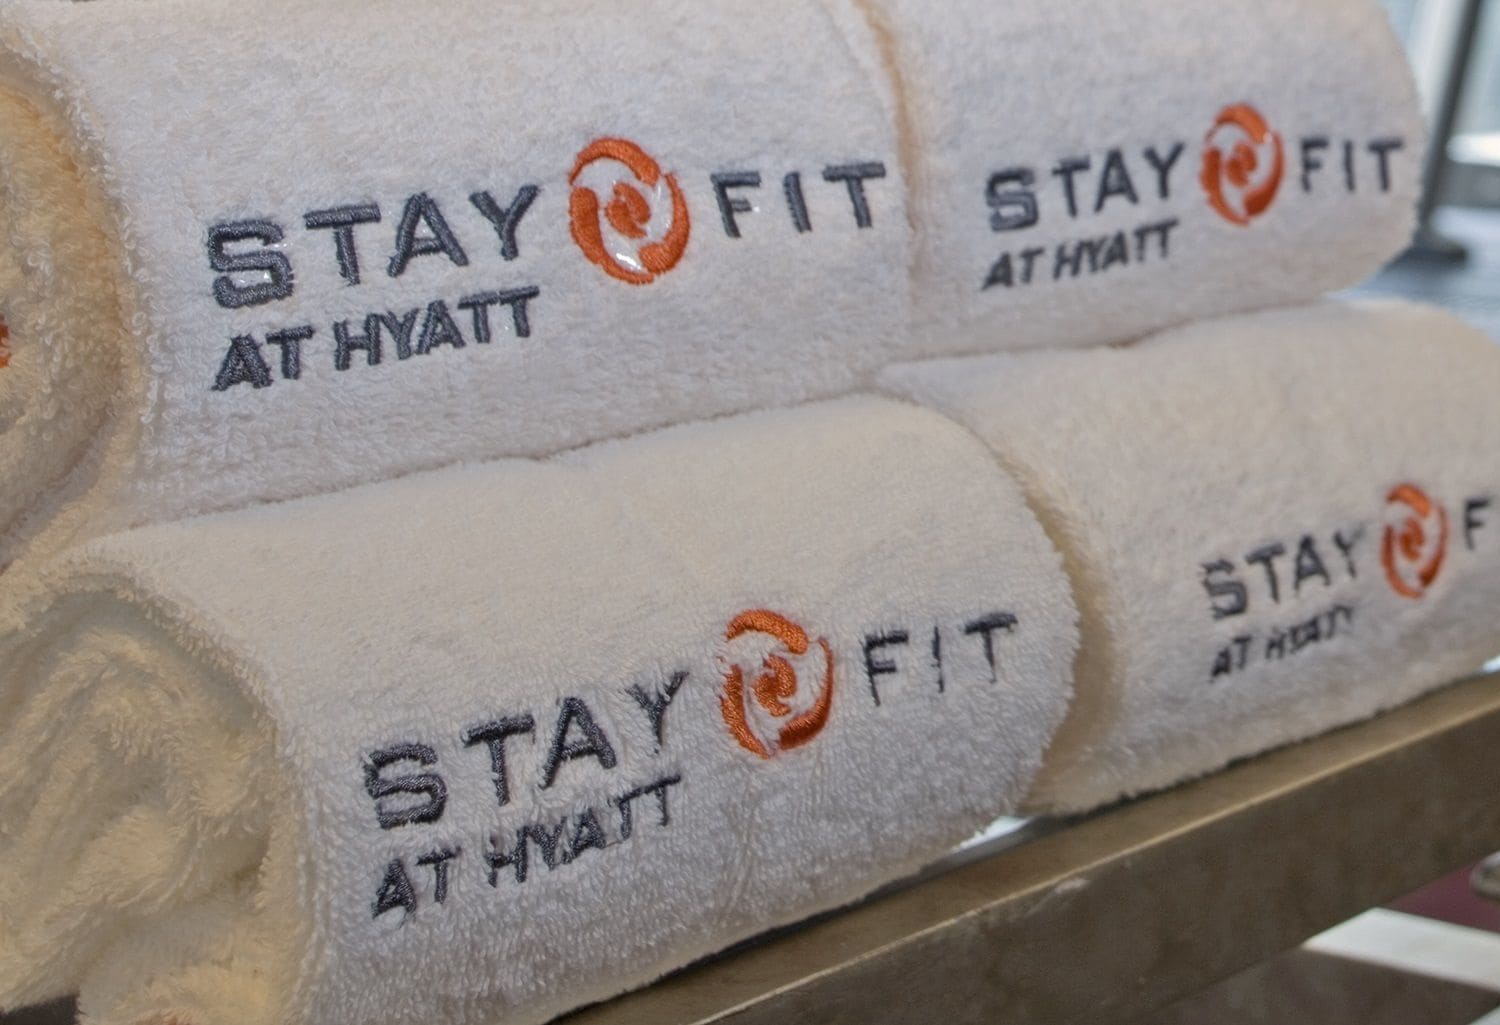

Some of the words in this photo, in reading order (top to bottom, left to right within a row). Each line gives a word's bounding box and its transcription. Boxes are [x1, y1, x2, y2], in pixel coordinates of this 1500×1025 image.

[985, 142, 1185, 232] STAY
[1301, 135, 1404, 193] FIT
[207, 184, 539, 308] STAY
[710, 162, 887, 238] FIT
[981, 247, 1044, 290] AT
[1052, 219, 1179, 280] HYATT
[211, 325, 315, 392] AT
[333, 286, 540, 371] HYATT
[1201, 524, 1367, 620] STAY
[1210, 636, 1251, 682] AT
[362, 672, 689, 829] STAY
[863, 612, 1018, 706] FIT
[371, 845, 461, 918] AT
[489, 775, 681, 887] HYATT
